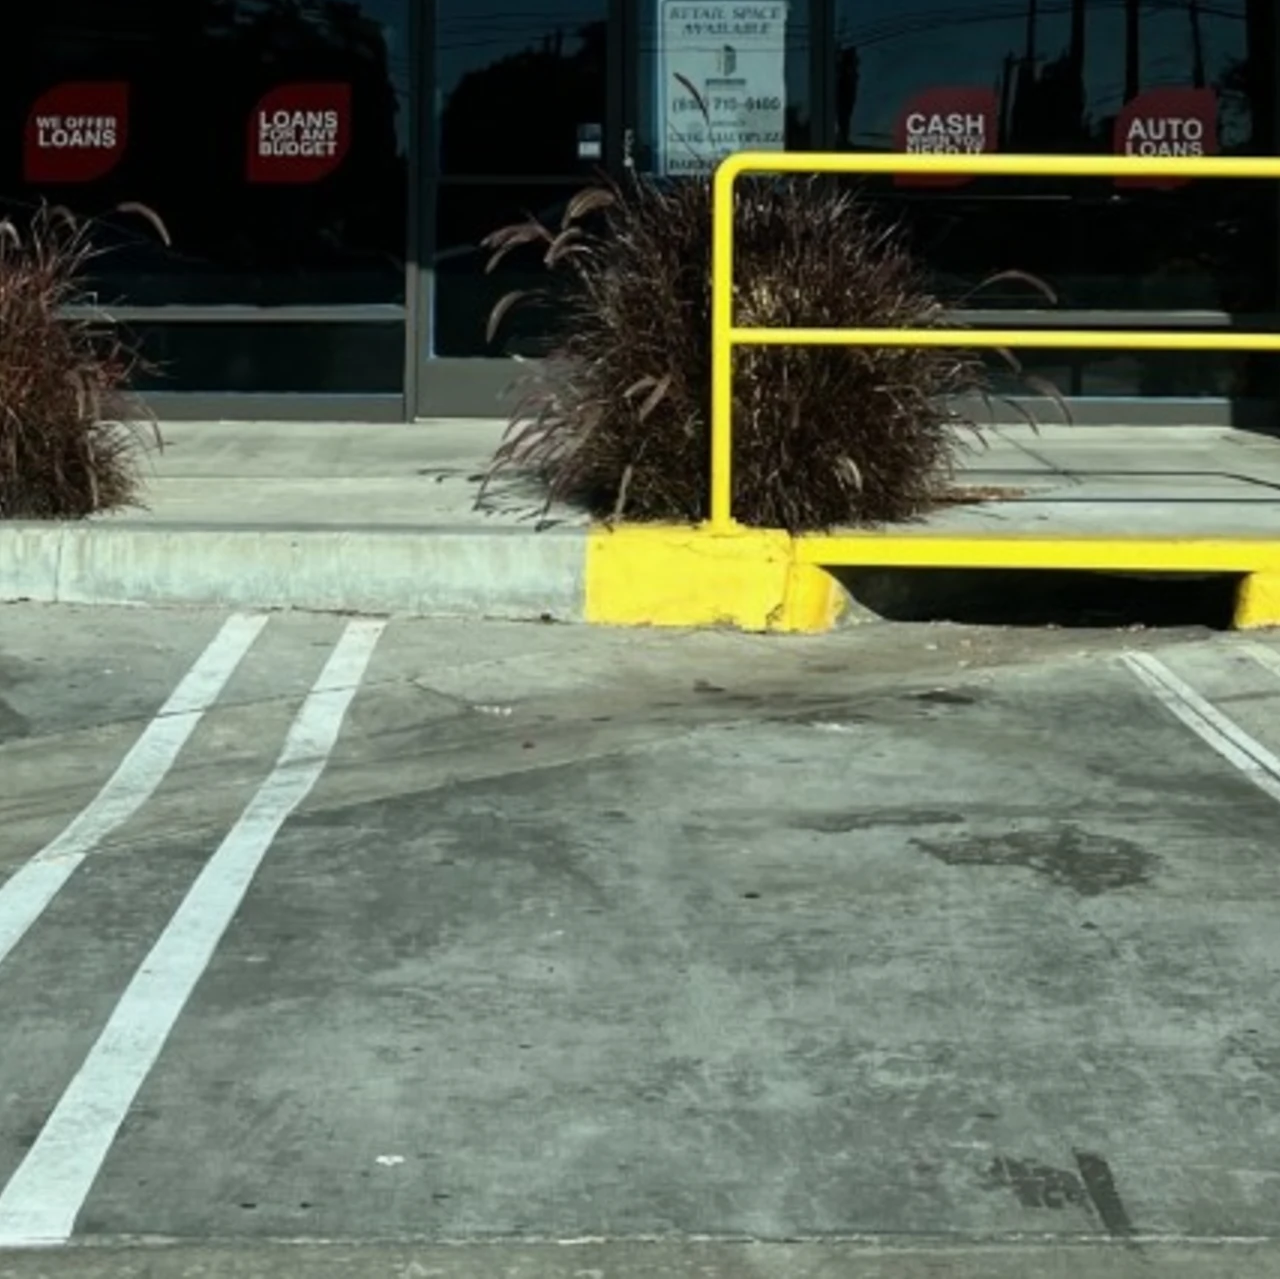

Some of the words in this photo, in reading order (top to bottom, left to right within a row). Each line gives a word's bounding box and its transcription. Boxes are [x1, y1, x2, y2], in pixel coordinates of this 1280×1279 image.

[669, 6, 725, 20] RETAIL
[732, 5, 781, 20] SPACE
[682, 21, 771, 36] AVAILABLE
[36, 116, 61, 129] WE
[64, 116, 117, 129] OFFER
[259, 110, 338, 128] LOANS
[906, 113, 985, 134] CASH
[259, 127, 297, 141] FOR
[301, 128, 338, 141] ANY
[1126, 117, 1204, 140] AUTO
[39, 128, 117, 148] LOANS
[906, 133, 950, 146] WHEN
[952, 133, 986, 147] YOU
[258, 140, 338, 157] BUDGET
[1125, 141, 1205, 157] LOANS
